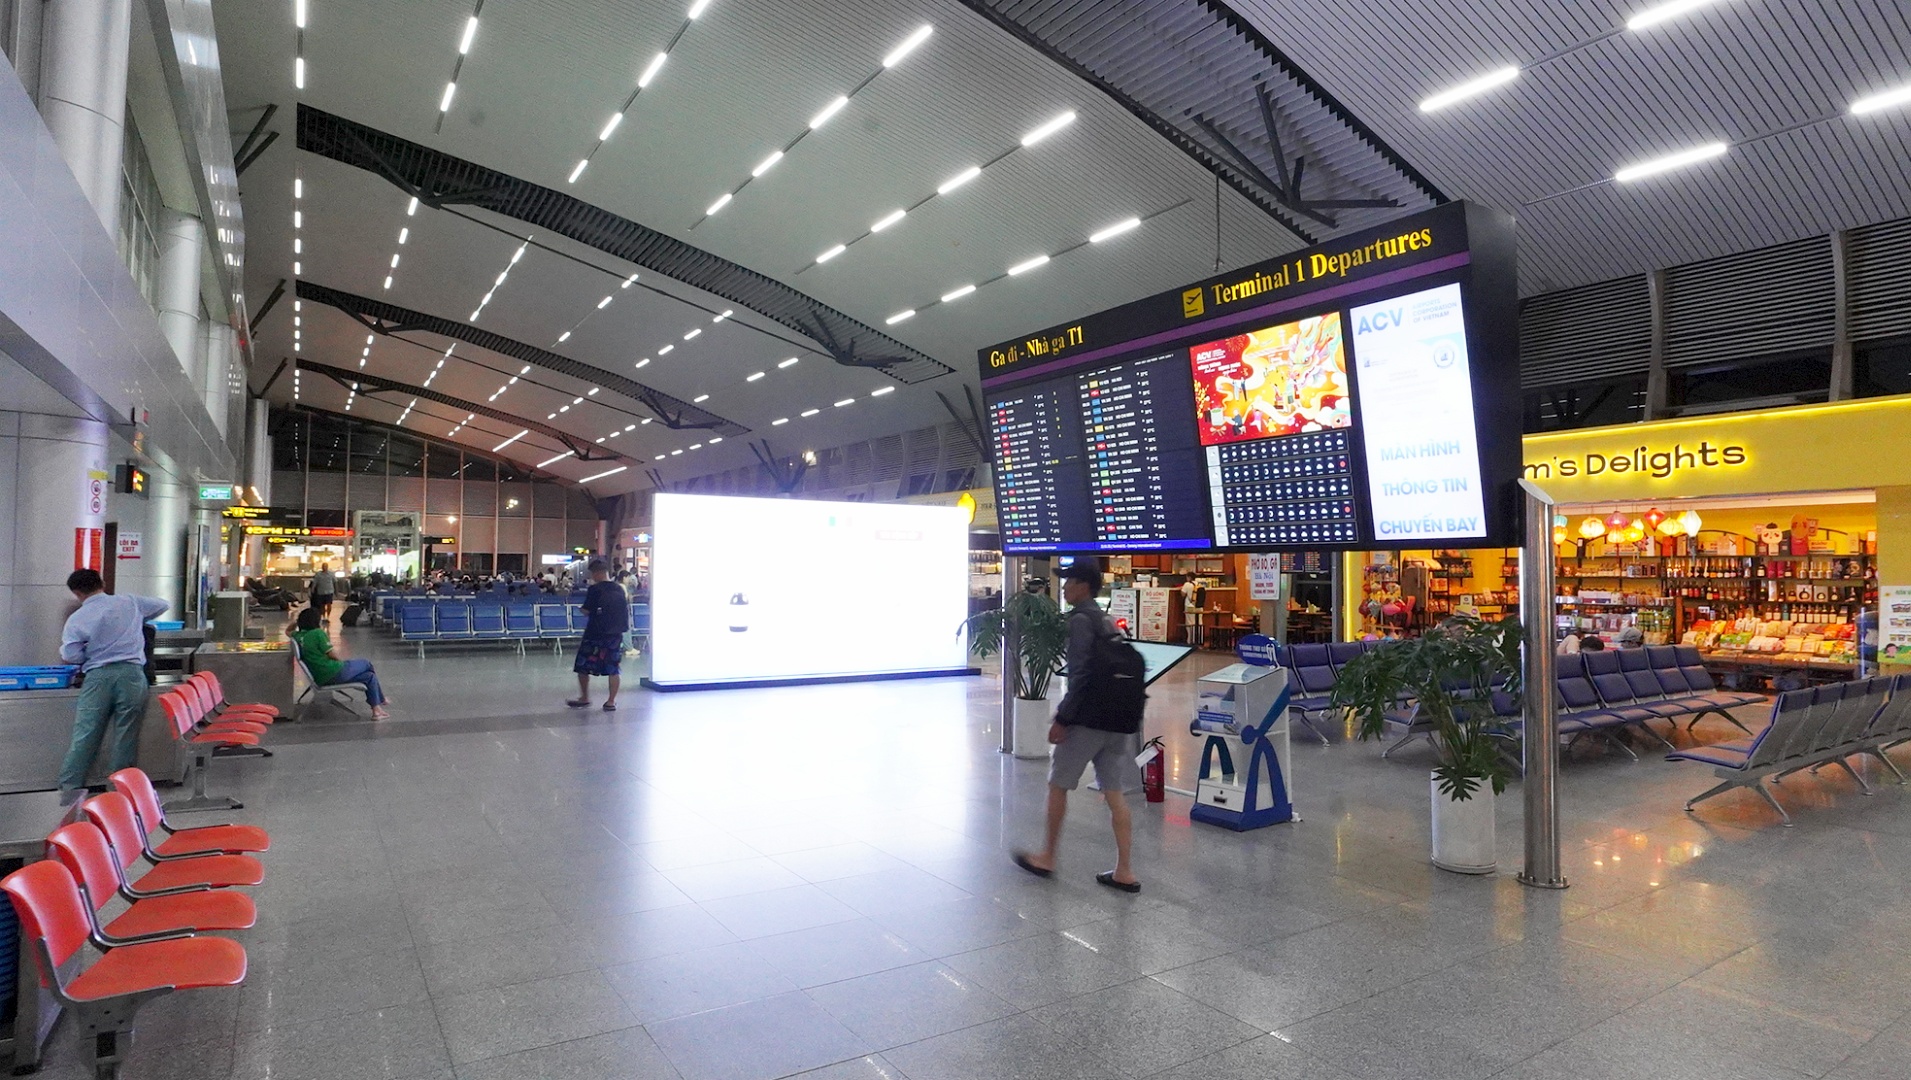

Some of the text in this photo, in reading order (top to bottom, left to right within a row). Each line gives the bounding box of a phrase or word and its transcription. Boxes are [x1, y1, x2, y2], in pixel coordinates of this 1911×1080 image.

[1211, 227, 1432, 305] Terminal 1 Departures
[1358, 307, 1403, 335] ACV
[990, 350, 1006, 368] Ga
[1026, 336, 1050, 358] Nhà
[1051, 336, 1066, 356] ga
[1066, 325, 1084, 347] T1
[1420, 439, 1461, 457] HÌNH
[1586, 441, 1746, 478] Delights
[1382, 477, 1468, 496] THÔNG TIN
[1379, 513, 1478, 534] CHUYẾN BAY
